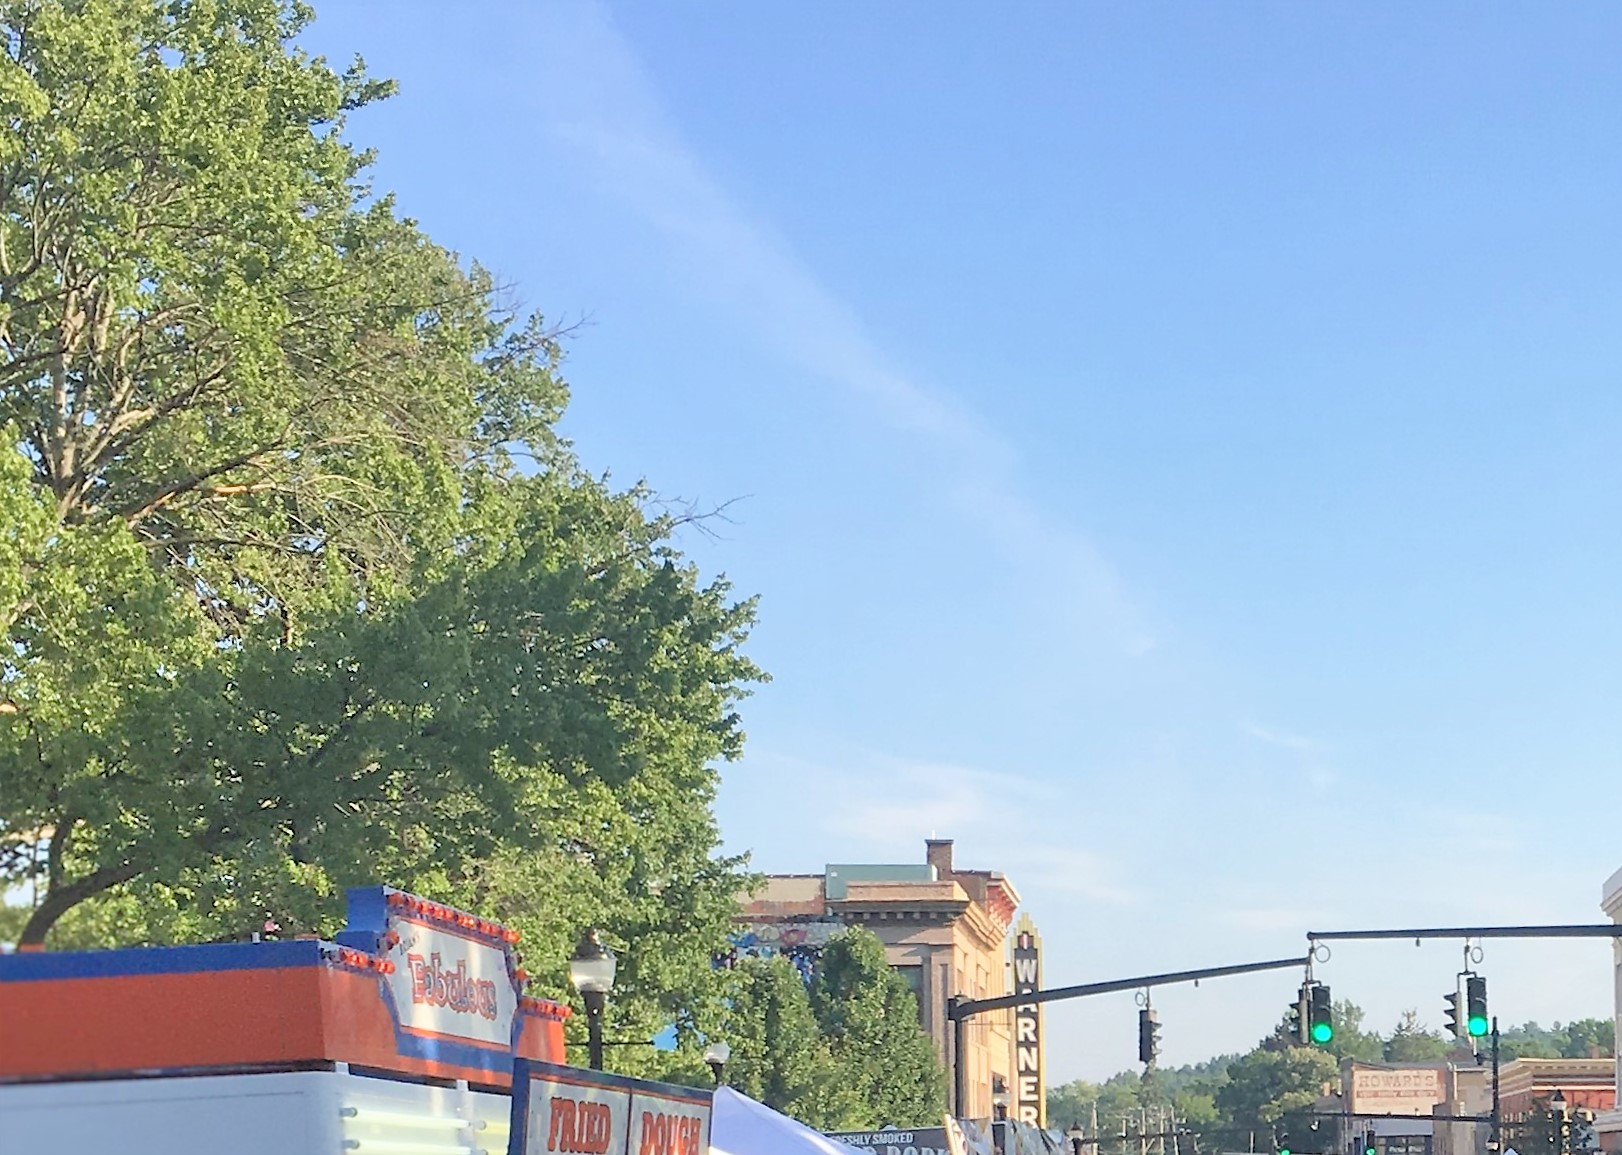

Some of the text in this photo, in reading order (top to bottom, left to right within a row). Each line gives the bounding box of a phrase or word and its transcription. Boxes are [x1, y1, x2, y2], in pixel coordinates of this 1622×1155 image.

[1016, 958, 1039, 1130] WARNER
[547, 1096, 612, 1155] FRIED
[872, 1133, 914, 1145] SMOKED
